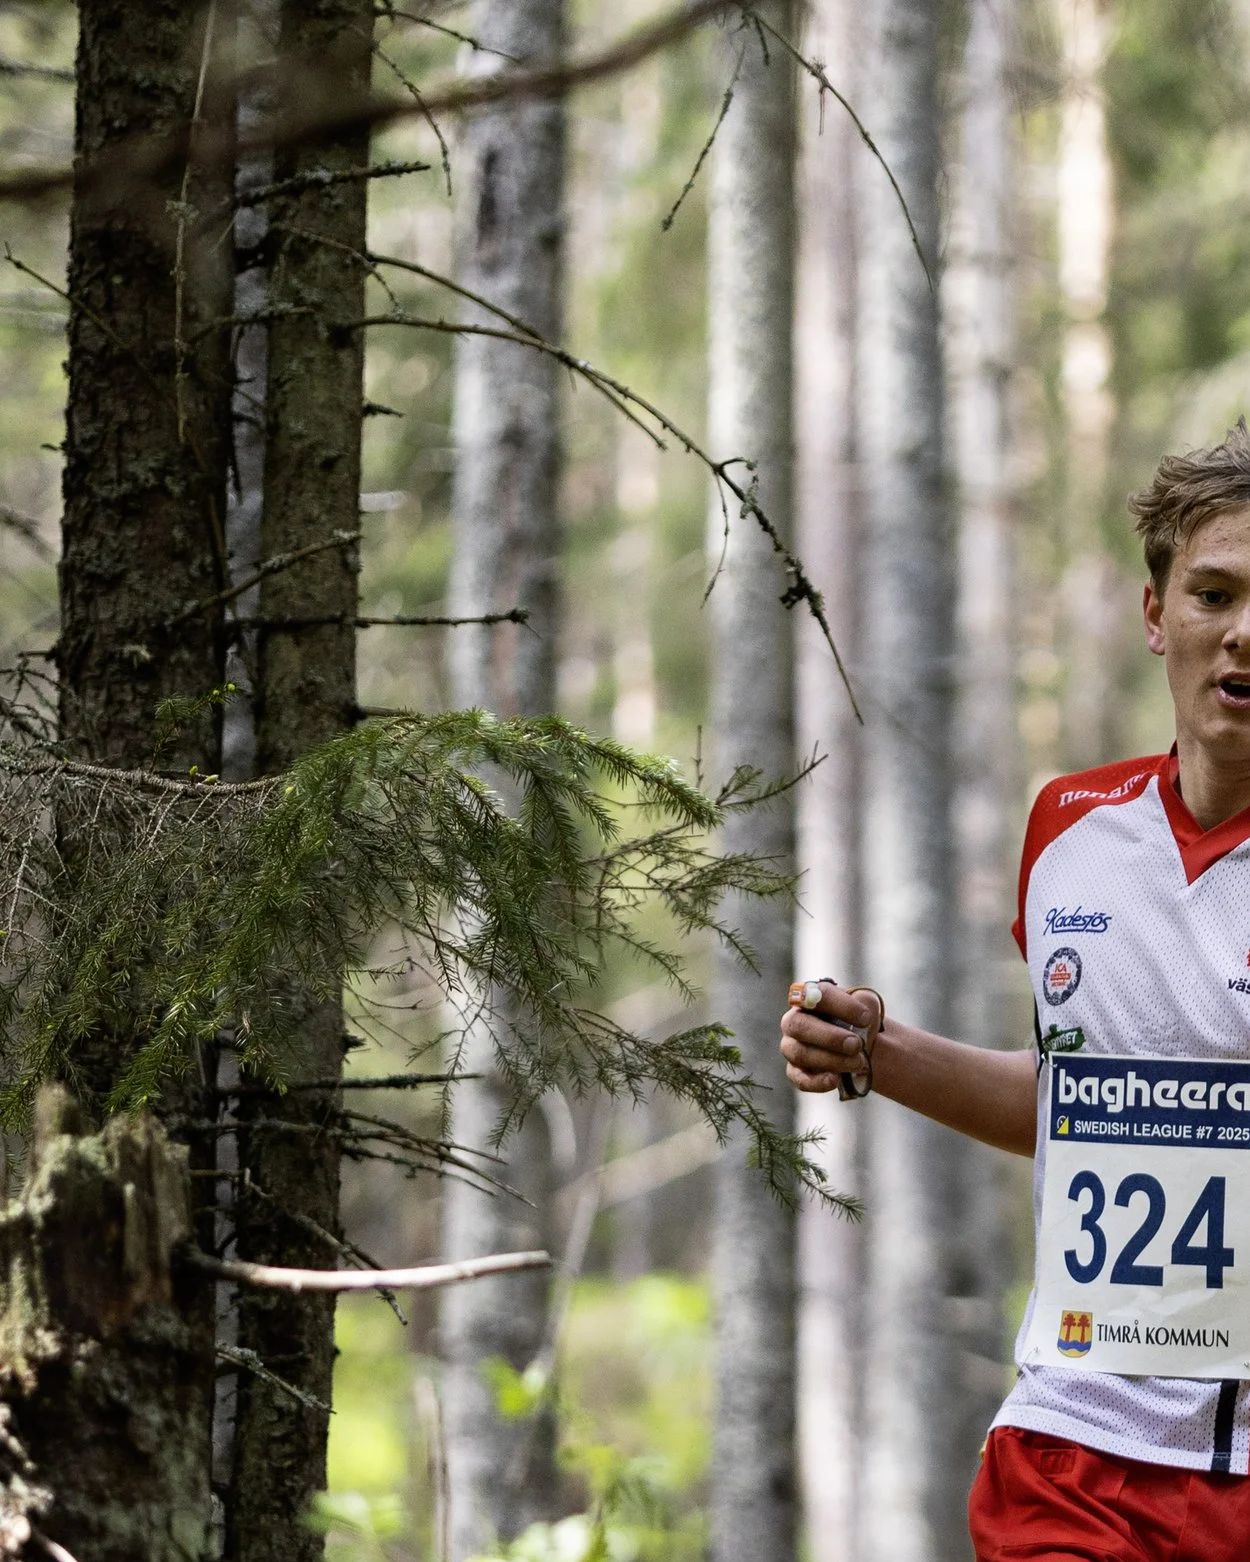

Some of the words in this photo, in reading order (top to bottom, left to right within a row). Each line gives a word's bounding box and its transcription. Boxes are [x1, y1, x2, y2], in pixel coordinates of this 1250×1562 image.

[1058, 770, 1150, 808] nonam
[1074, 1120, 1130, 1136] SWEDISH
[1133, 1123, 1192, 1139] LEAGUE
[1195, 1125, 1214, 1140] #7
[1217, 1126, 1250, 1141] 2025
[1064, 1170, 1235, 1289] 324
[1097, 1319, 1142, 1344] TIMRÅ
[1145, 1326, 1230, 1347] KOMMUN
